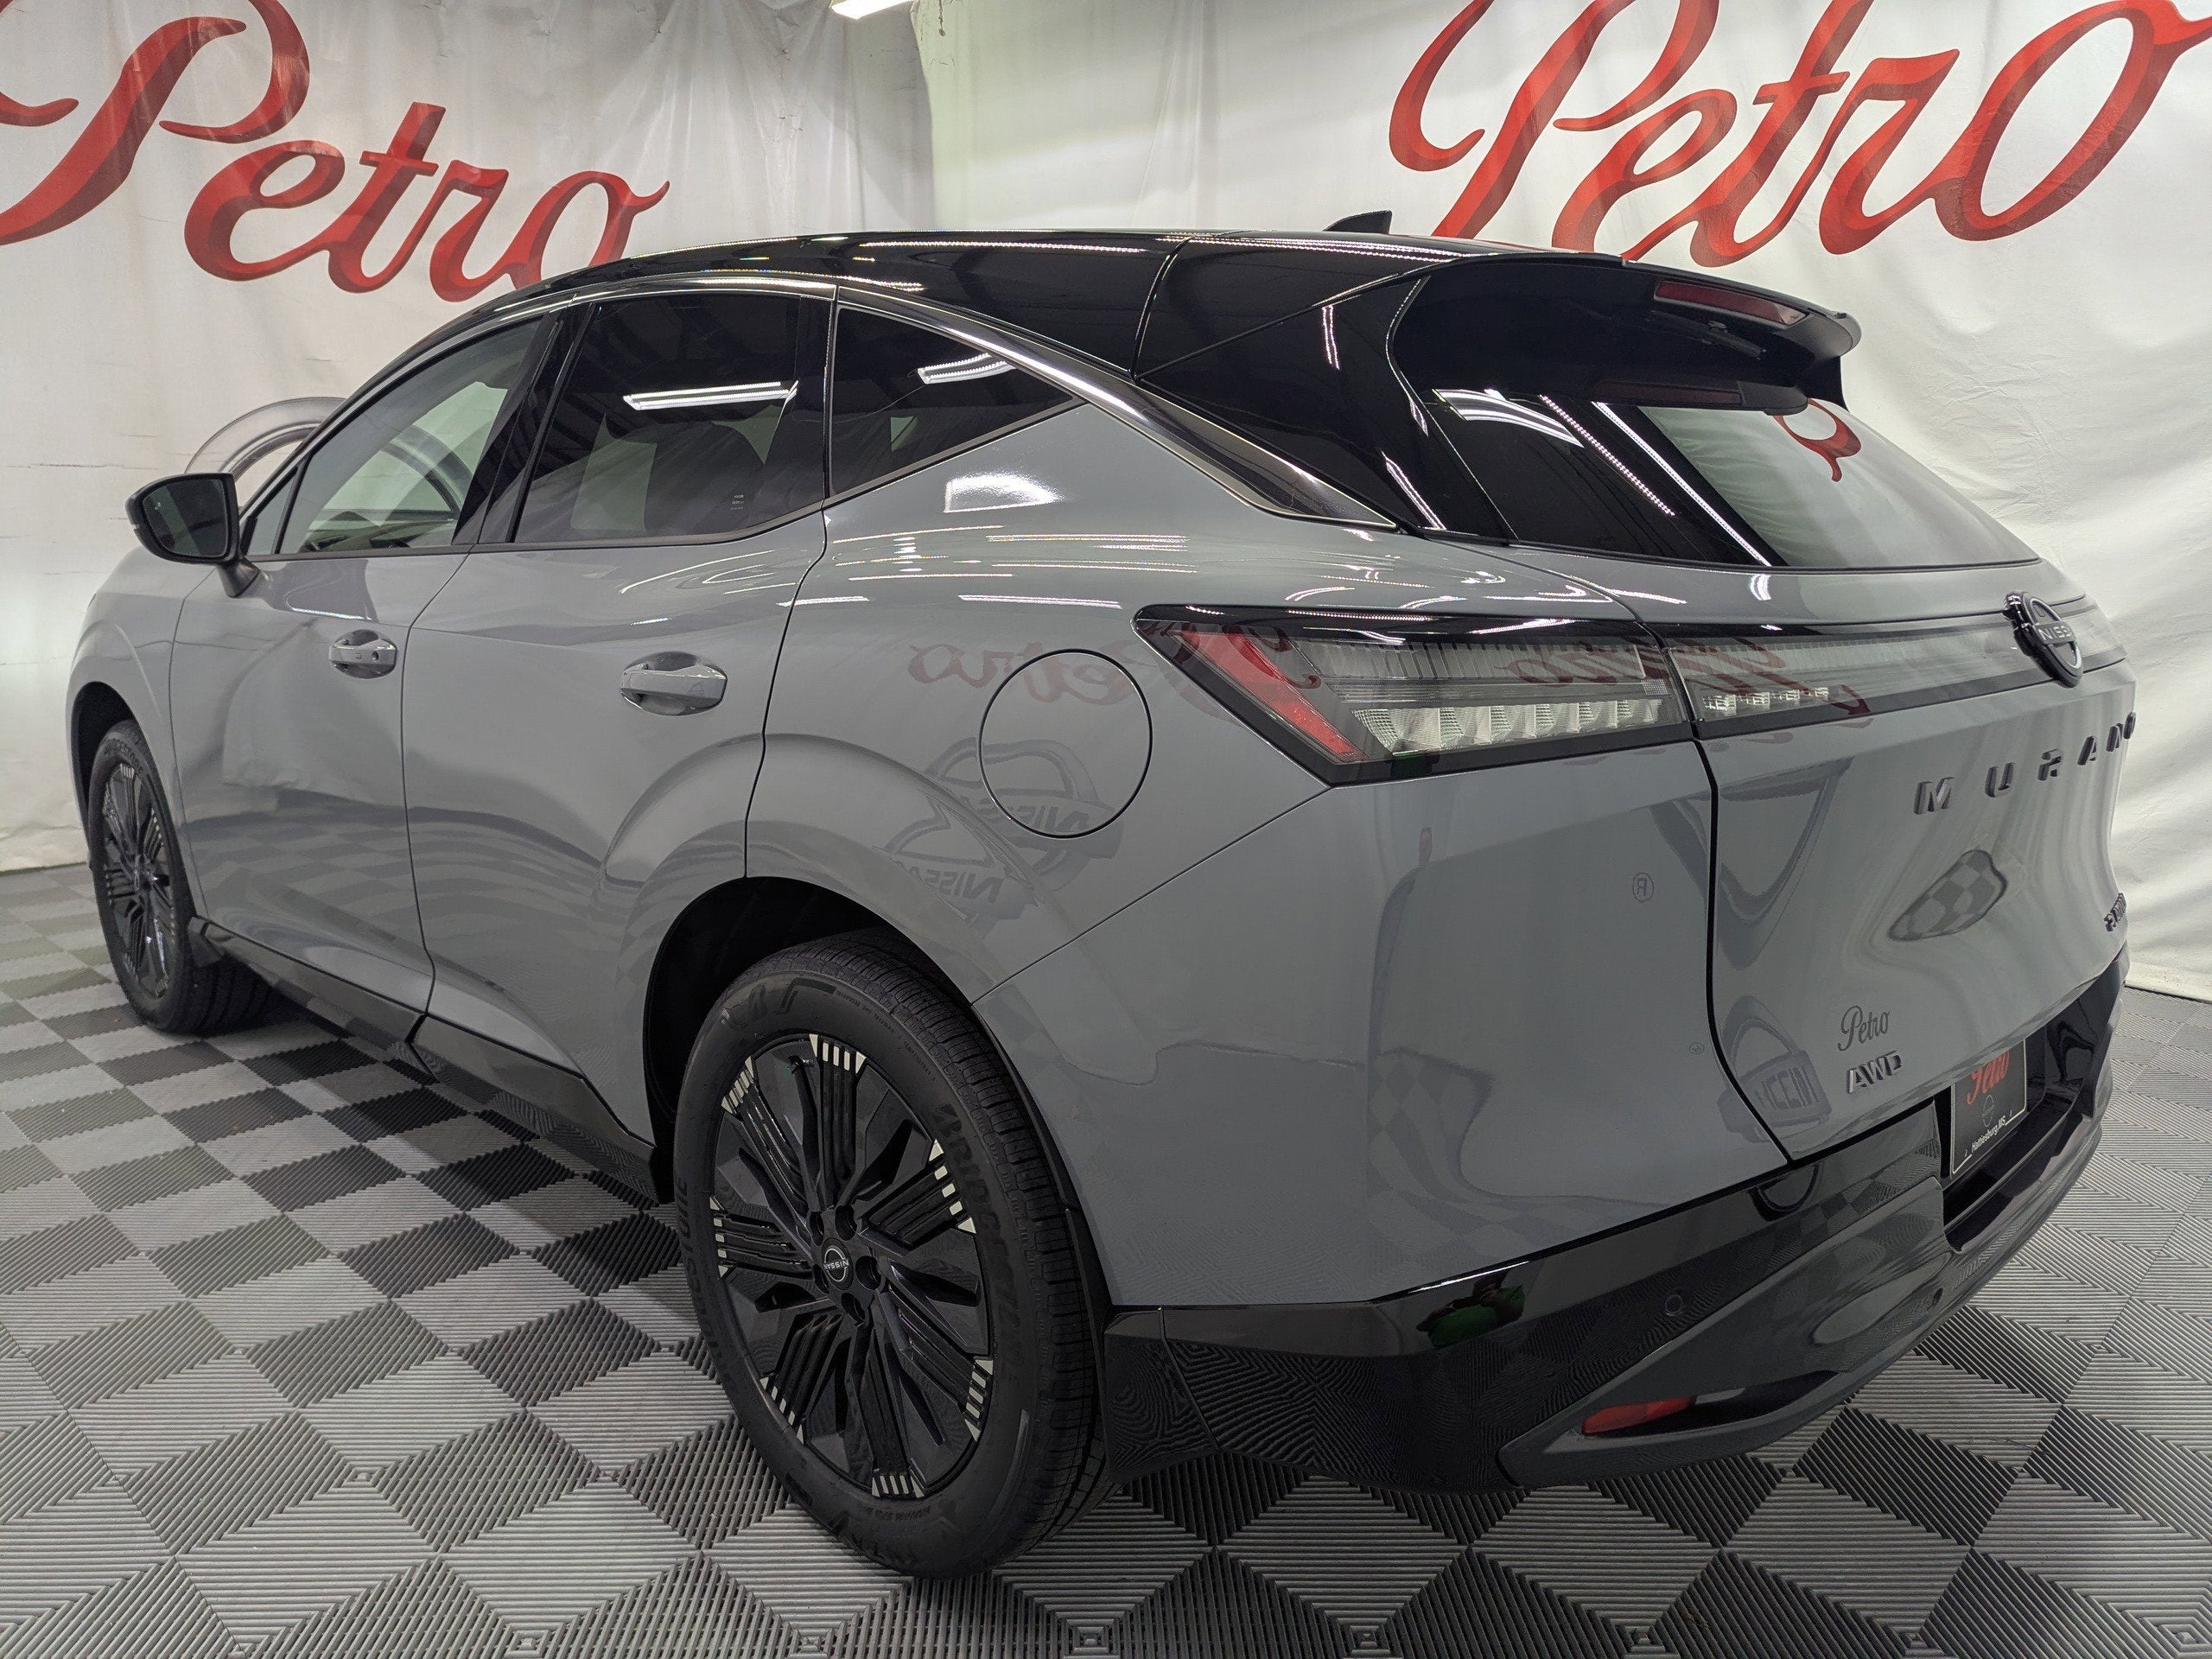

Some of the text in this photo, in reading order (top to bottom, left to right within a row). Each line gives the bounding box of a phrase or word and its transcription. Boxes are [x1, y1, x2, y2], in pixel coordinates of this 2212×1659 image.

[0, 0, 671, 303] Petro
[1389, 0, 2212, 268] Petro
[1913, 711, 2137, 815] MURANO
[1837, 1005, 1891, 1052] Petro
[1847, 1051, 1903, 1094] AWD
[823, 1259, 849, 1270] NISSAN
